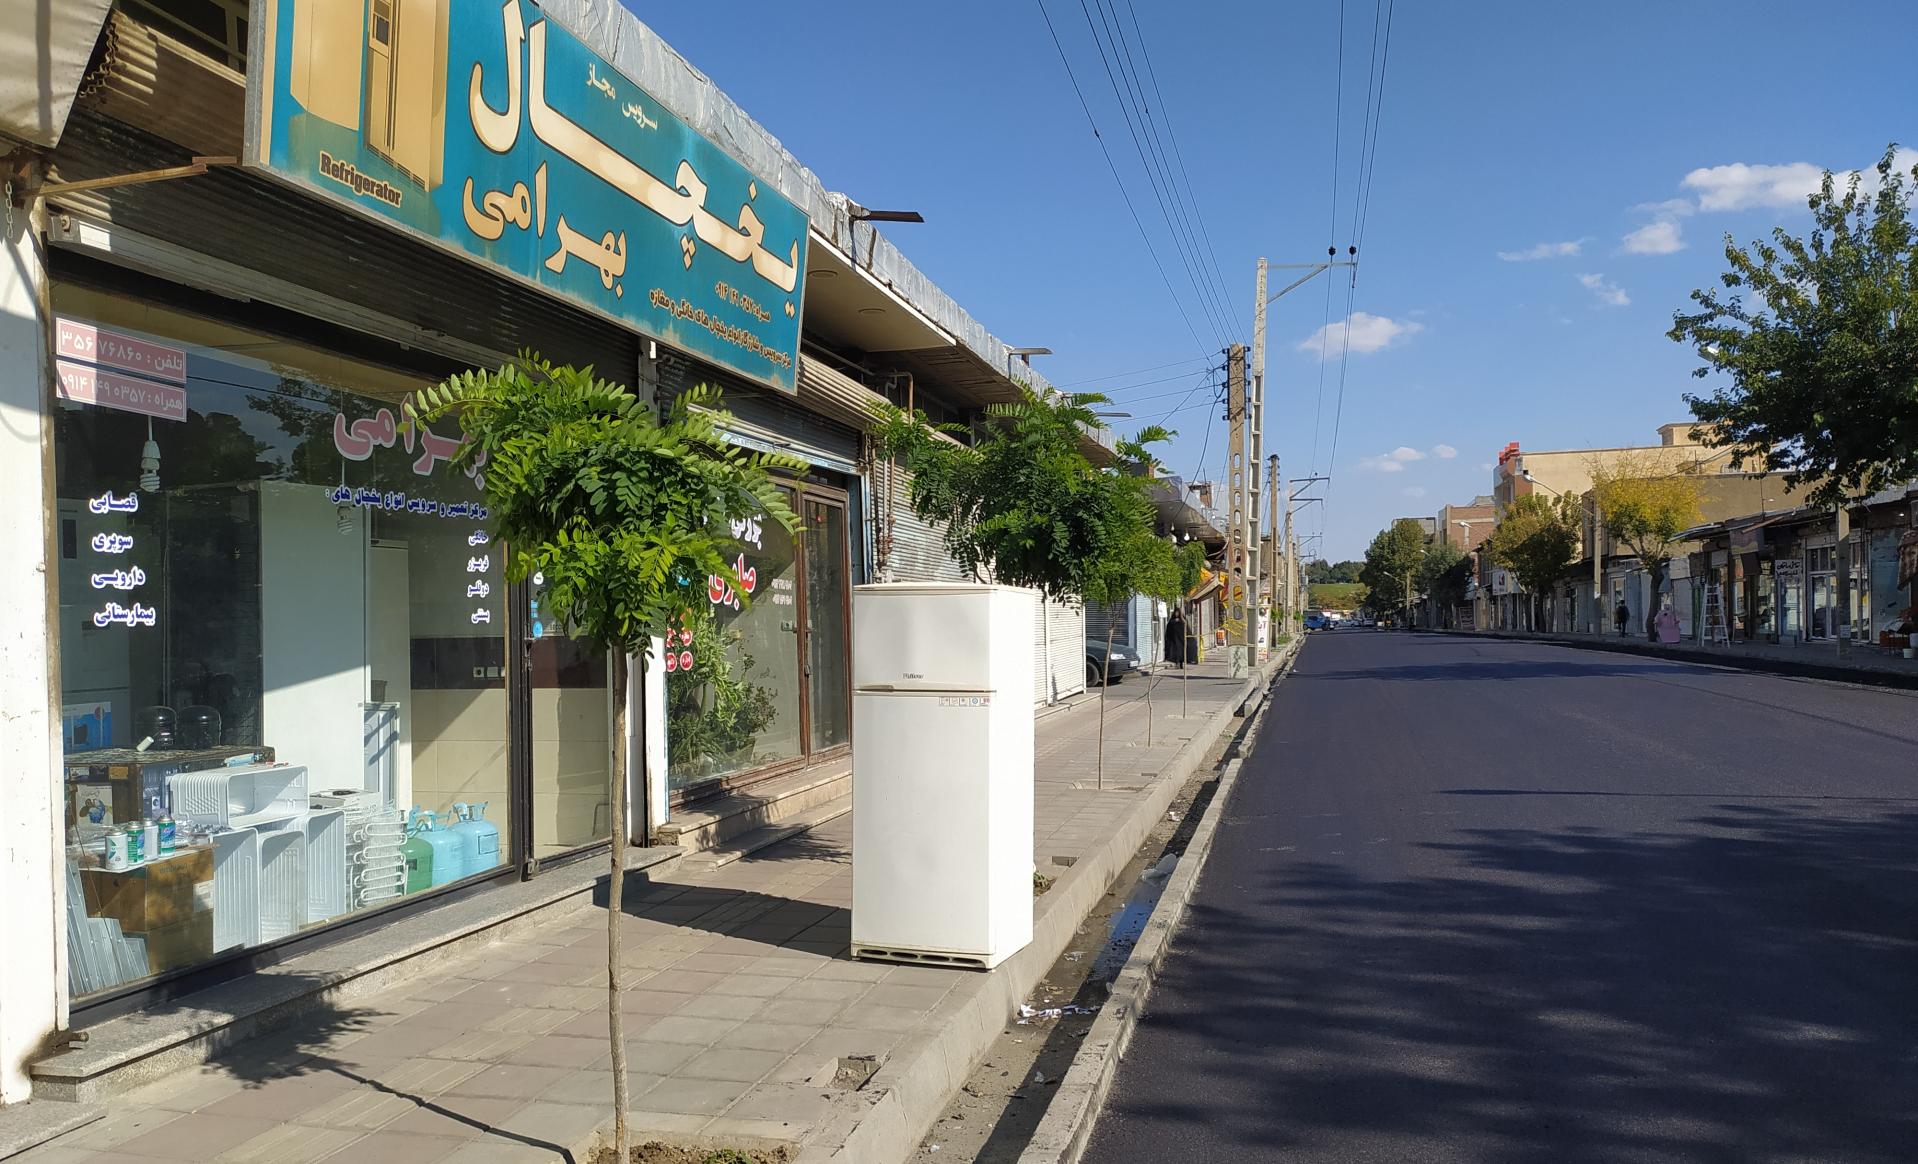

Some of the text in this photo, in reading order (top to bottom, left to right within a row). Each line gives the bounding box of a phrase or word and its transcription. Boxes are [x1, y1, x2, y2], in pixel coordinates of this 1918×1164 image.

[586, 62, 658, 131] سرویس مجاز
[468, 0, 799, 317] یخچال
[319, 150, 402, 208] Refrigerator
[462, 161, 628, 299] بهرامی
[649, 288, 670, 309] مغازه
[675, 299, 695, 322] خانگی
[695, 308, 709, 329] های
[708, 315, 728, 340] یخچال
[61, 373, 89, 392] ۰۹۱۴
[113, 384, 146, 403] ۰۳۵۷
[89, 490, 138, 514] قصابی
[354, 486, 383, 510] یخچال
[384, 491, 405, 510] انواع
[406, 497, 437, 514] سرویس
[439, 503, 446, 517] و
[447, 501, 469, 518] تعمیر
[469, 502, 489, 520] مرکز
[92, 532, 133, 553] سوپری
[468, 529, 489, 547] خانگی
[467, 554, 489, 572] فریزر
[92, 565, 145, 590] دارویی
[467, 579, 489, 598] دوقلو
[94, 602, 156, 627] بیمارستانی
[471, 608, 491, 624] بستنی
